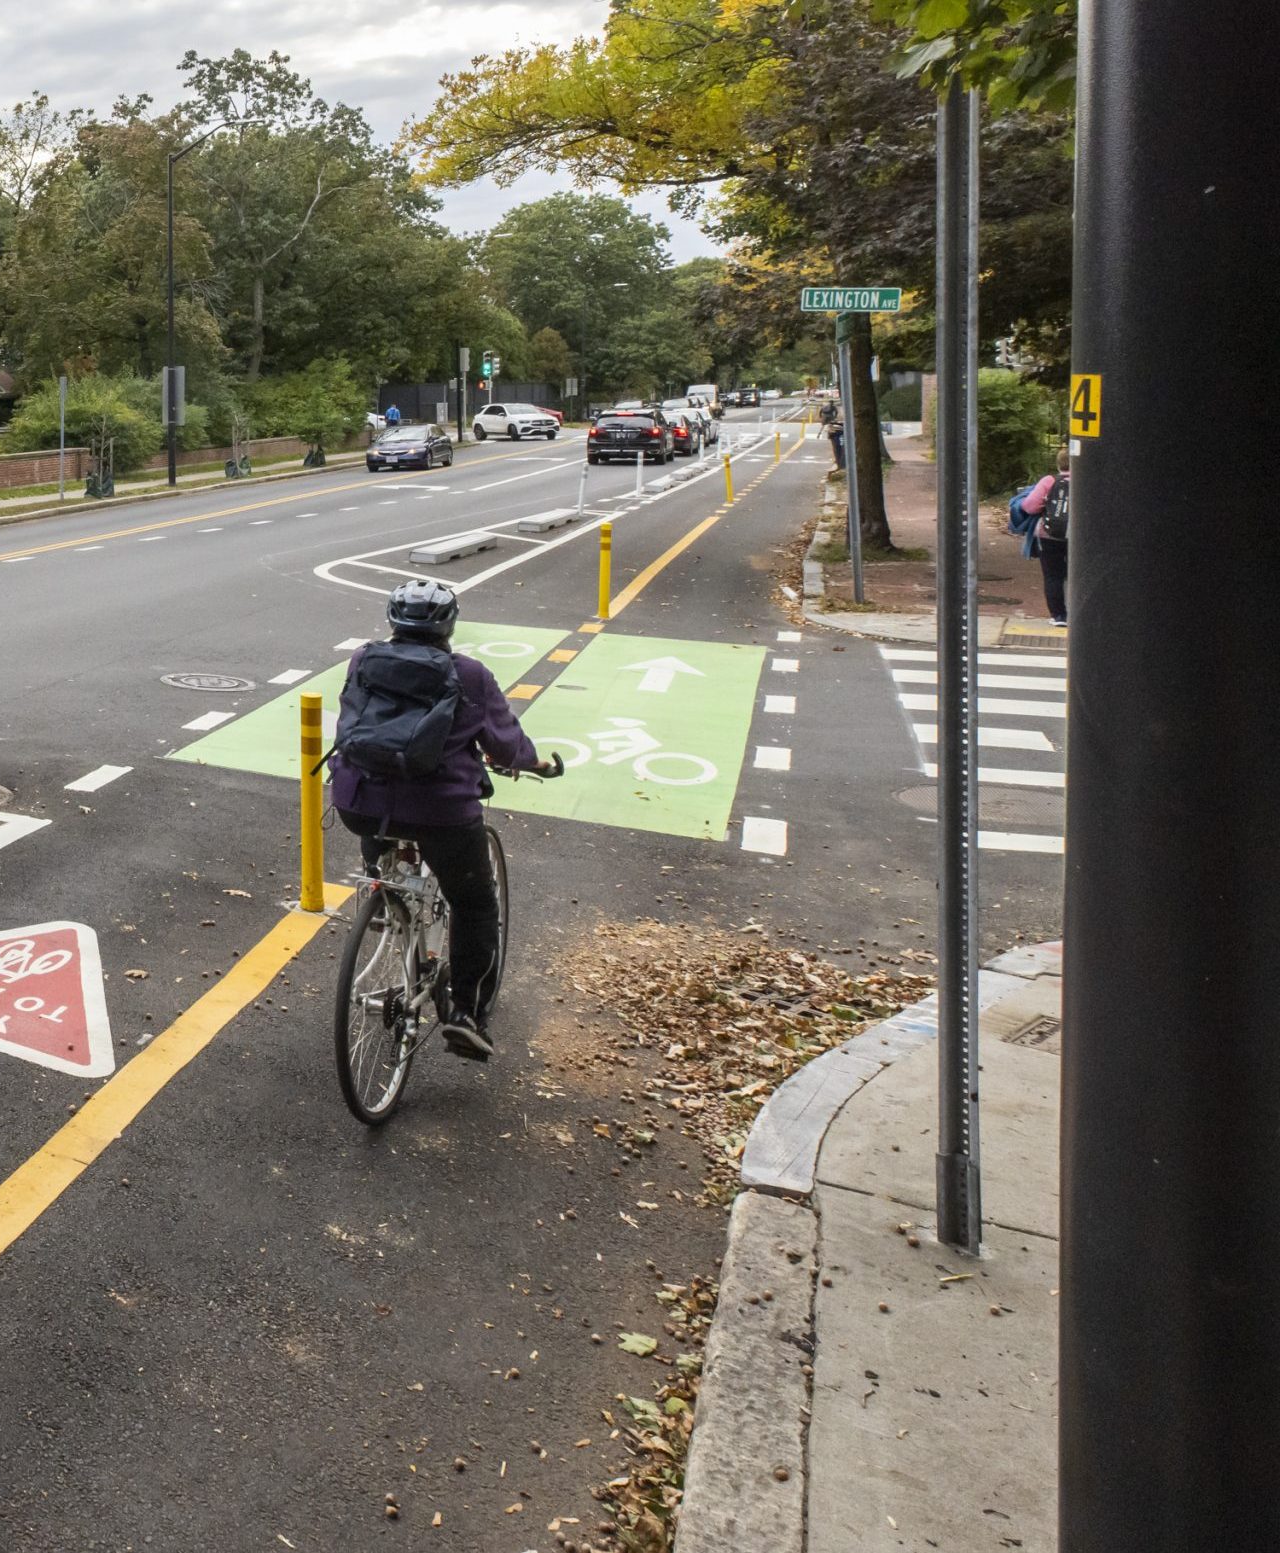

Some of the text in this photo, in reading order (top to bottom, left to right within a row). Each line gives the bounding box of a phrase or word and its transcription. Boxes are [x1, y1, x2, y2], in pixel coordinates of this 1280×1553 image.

[805, 291, 897, 309] LEXINGTON AVE
[1072, 378, 1097, 432] 4
[13, 996, 69, 1023] TO
